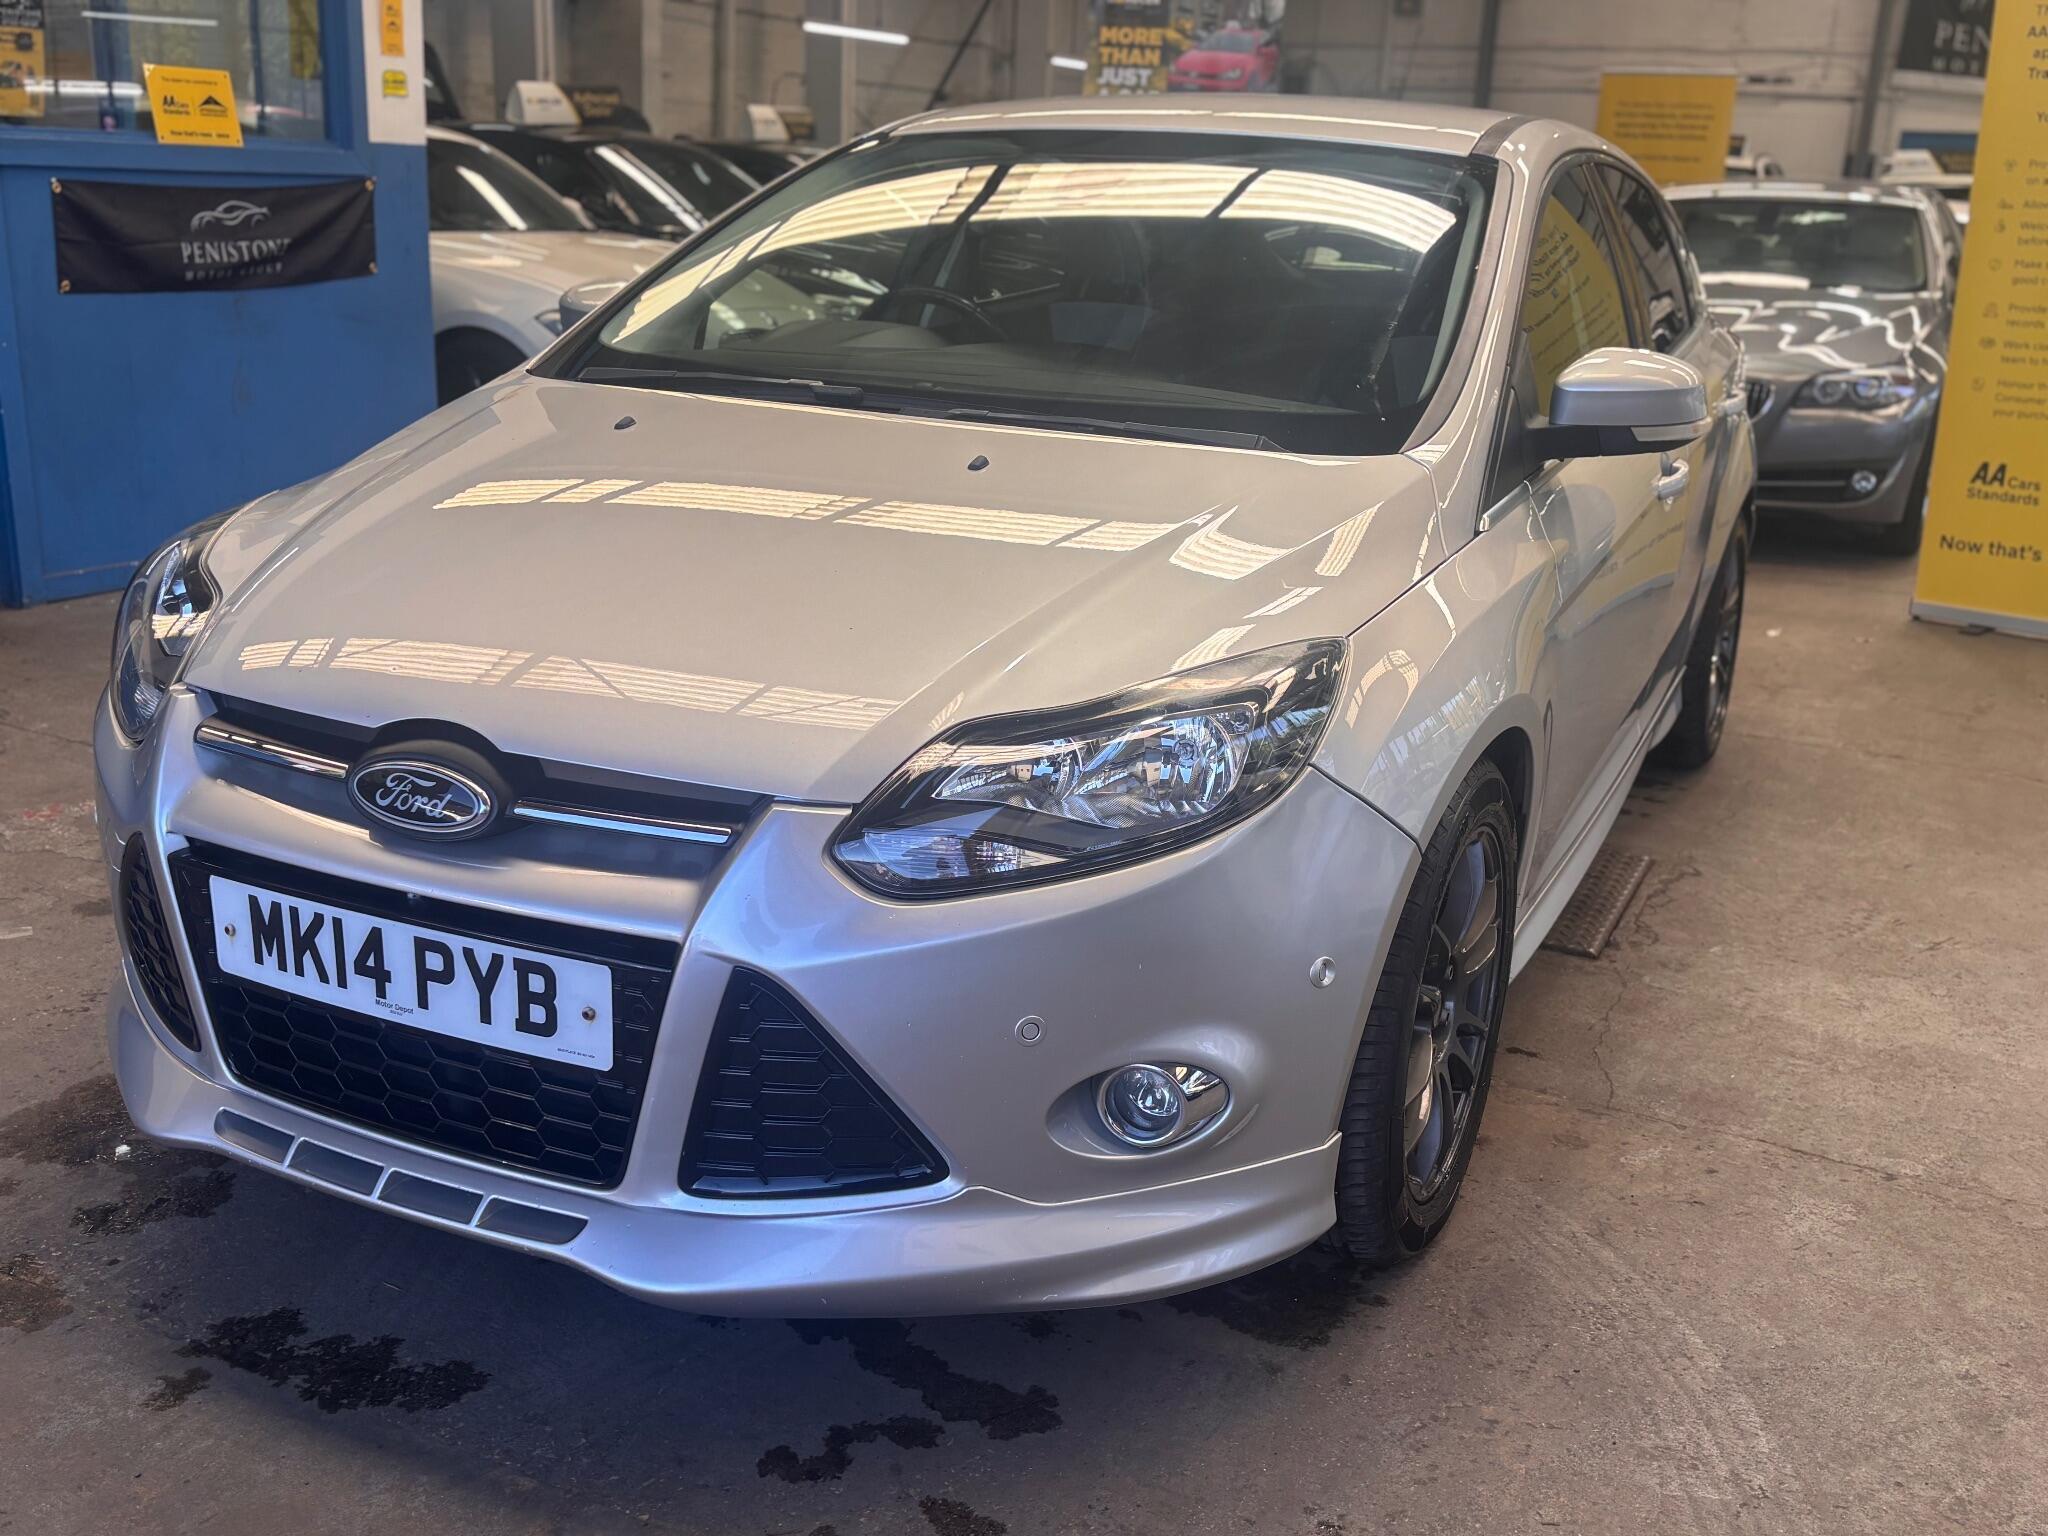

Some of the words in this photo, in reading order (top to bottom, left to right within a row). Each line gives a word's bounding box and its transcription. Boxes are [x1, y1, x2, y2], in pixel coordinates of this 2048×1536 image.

[1100, 26, 1162, 46] MORE
[1100, 47, 1161, 66] THAN
[1097, 67, 1151, 86] JUST
[1968, 461, 2008, 487] AA
[2008, 476, 2042, 492] Cars
[1966, 487, 2040, 506] Standards
[1940, 534, 1984, 553] Now
[1988, 541, 2043, 562] that's
[375, 772, 454, 819] Ford
[247, 894, 392, 1000] MK14
[413, 935, 558, 1038] PYB
[375, 998, 394, 1009] Motor
[394, 1003, 414, 1015] Depot
